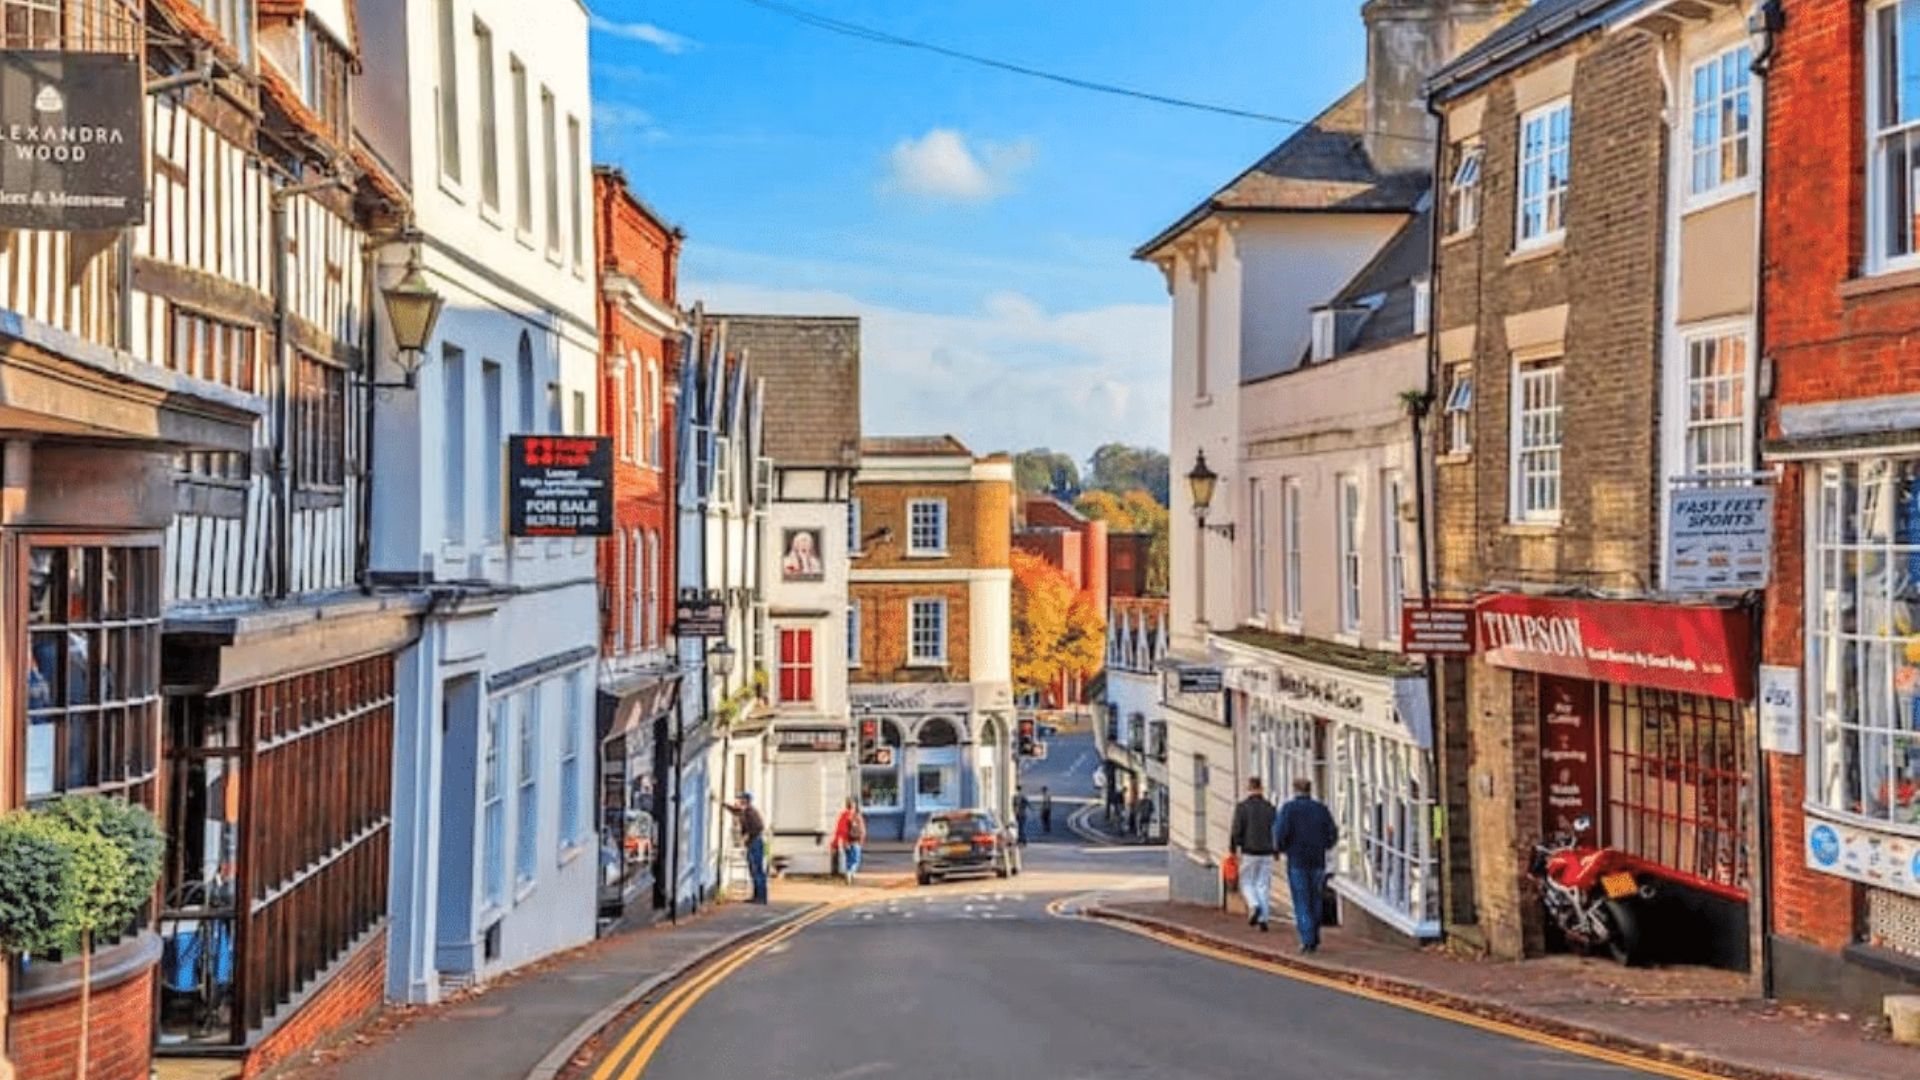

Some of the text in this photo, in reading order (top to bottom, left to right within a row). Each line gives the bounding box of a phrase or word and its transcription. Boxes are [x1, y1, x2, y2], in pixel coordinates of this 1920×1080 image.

[16, 144, 86, 161] WOOD
[526, 499, 598, 513] FOR SALE
[1676, 498, 1766, 514] FAST FEET
[1688, 513, 1755, 528] SPORTS
[1482, 611, 1585, 657] TIMPSON
